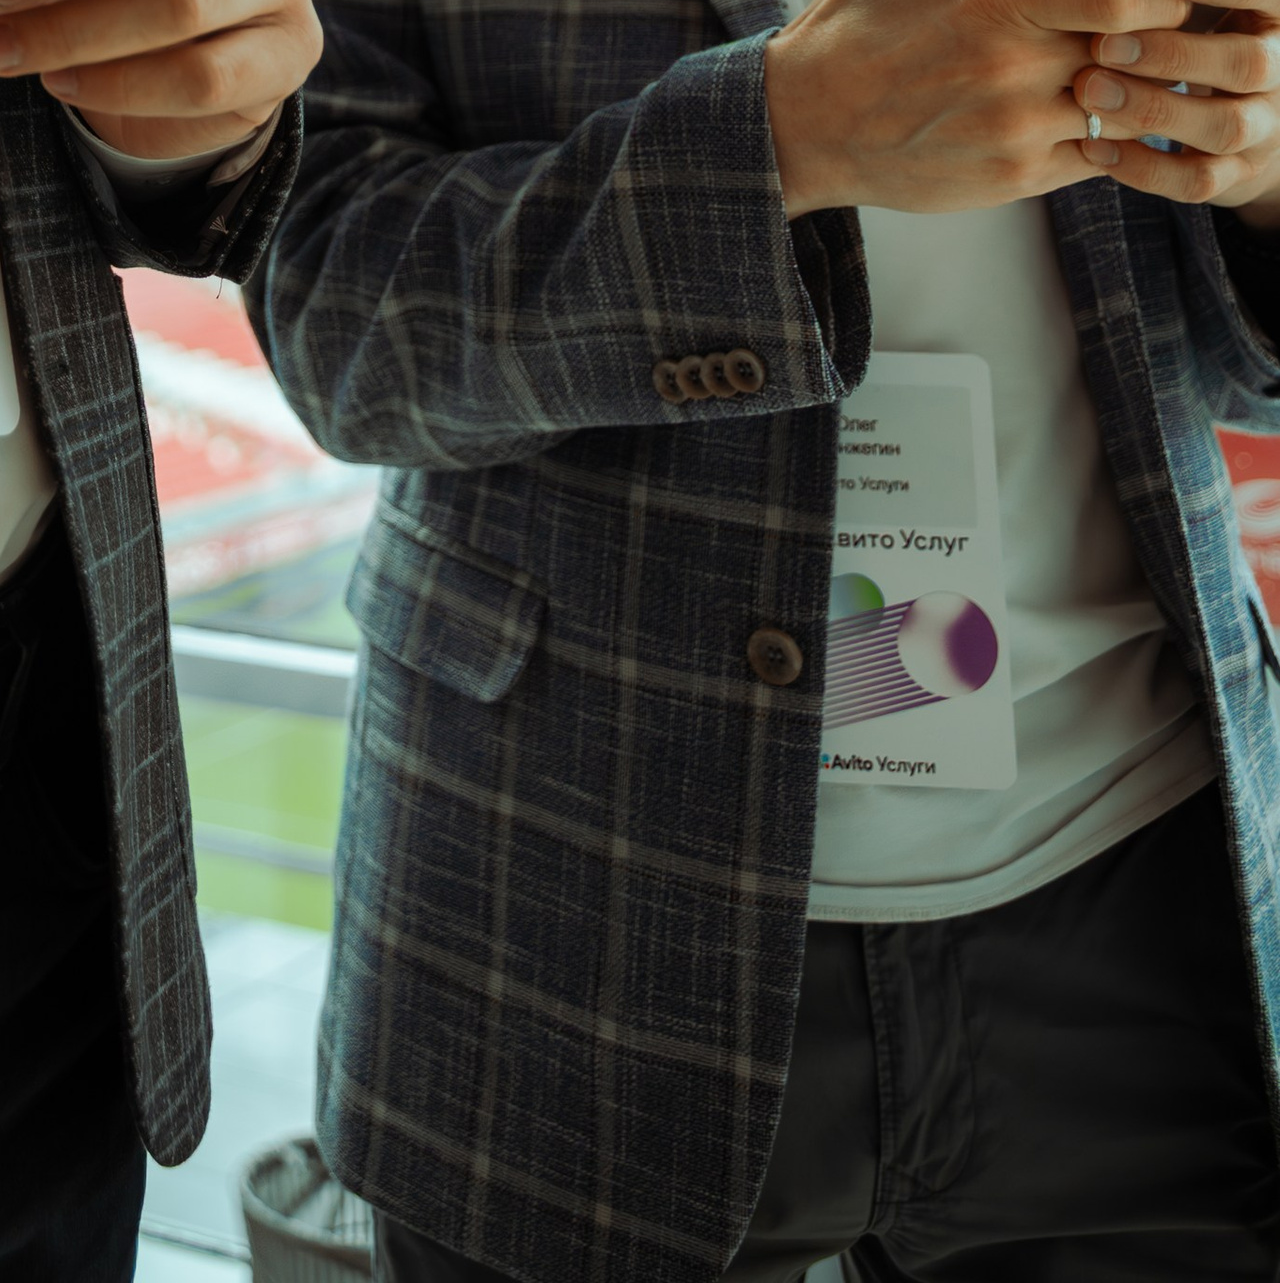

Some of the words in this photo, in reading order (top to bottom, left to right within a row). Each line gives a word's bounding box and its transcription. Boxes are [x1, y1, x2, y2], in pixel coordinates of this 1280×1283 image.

[859, 476, 910, 494] Услуги
[835, 532, 894, 549] вито
[899, 529, 969, 557] Услуг
[831, 754, 873, 771] Avito
[876, 756, 936, 776] Услуги
